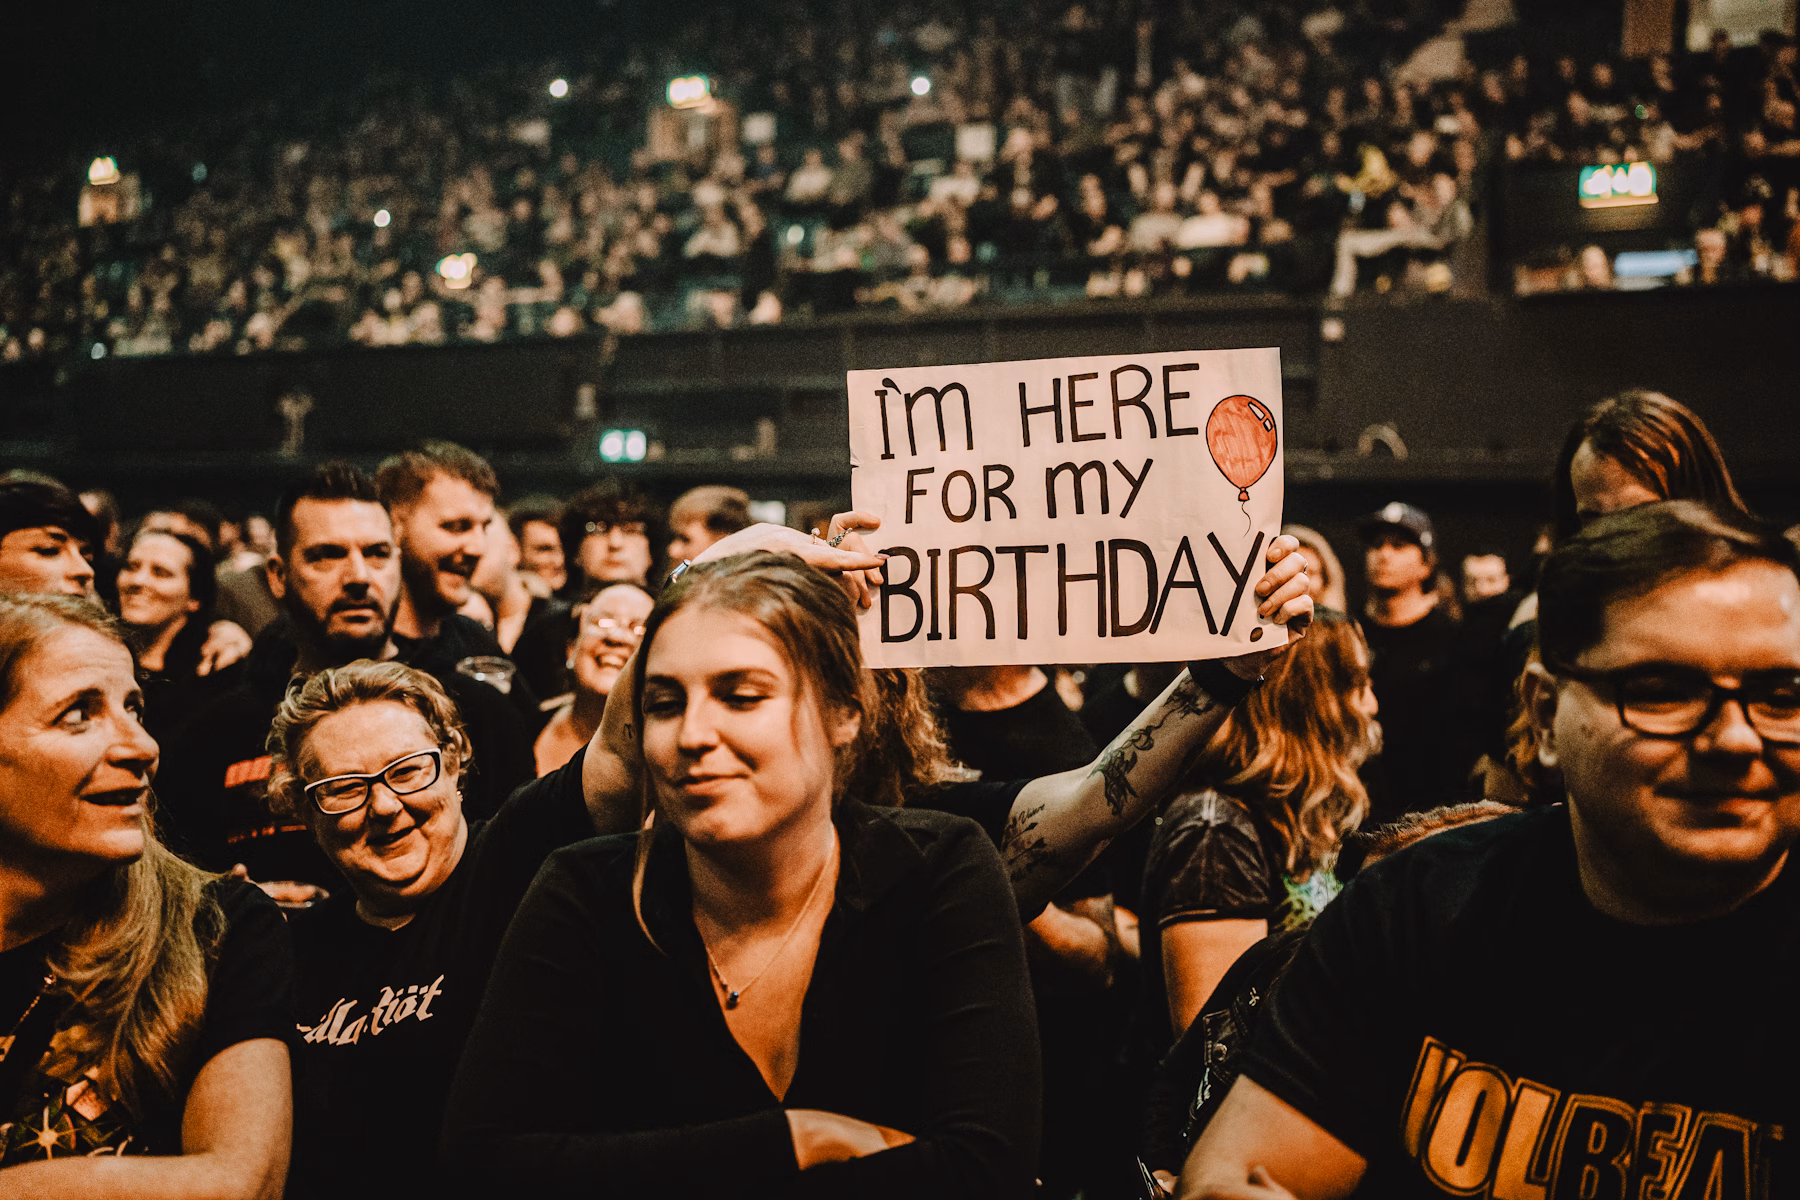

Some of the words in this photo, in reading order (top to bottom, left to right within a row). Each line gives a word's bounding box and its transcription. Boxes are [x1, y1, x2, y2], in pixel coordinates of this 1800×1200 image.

[1018, 363, 1200, 448] HERE
[905, 464, 1017, 524] FOR
[878, 530, 1264, 643] BIRTHDAY
[1400, 1035, 1785, 1200] VOLBEA
